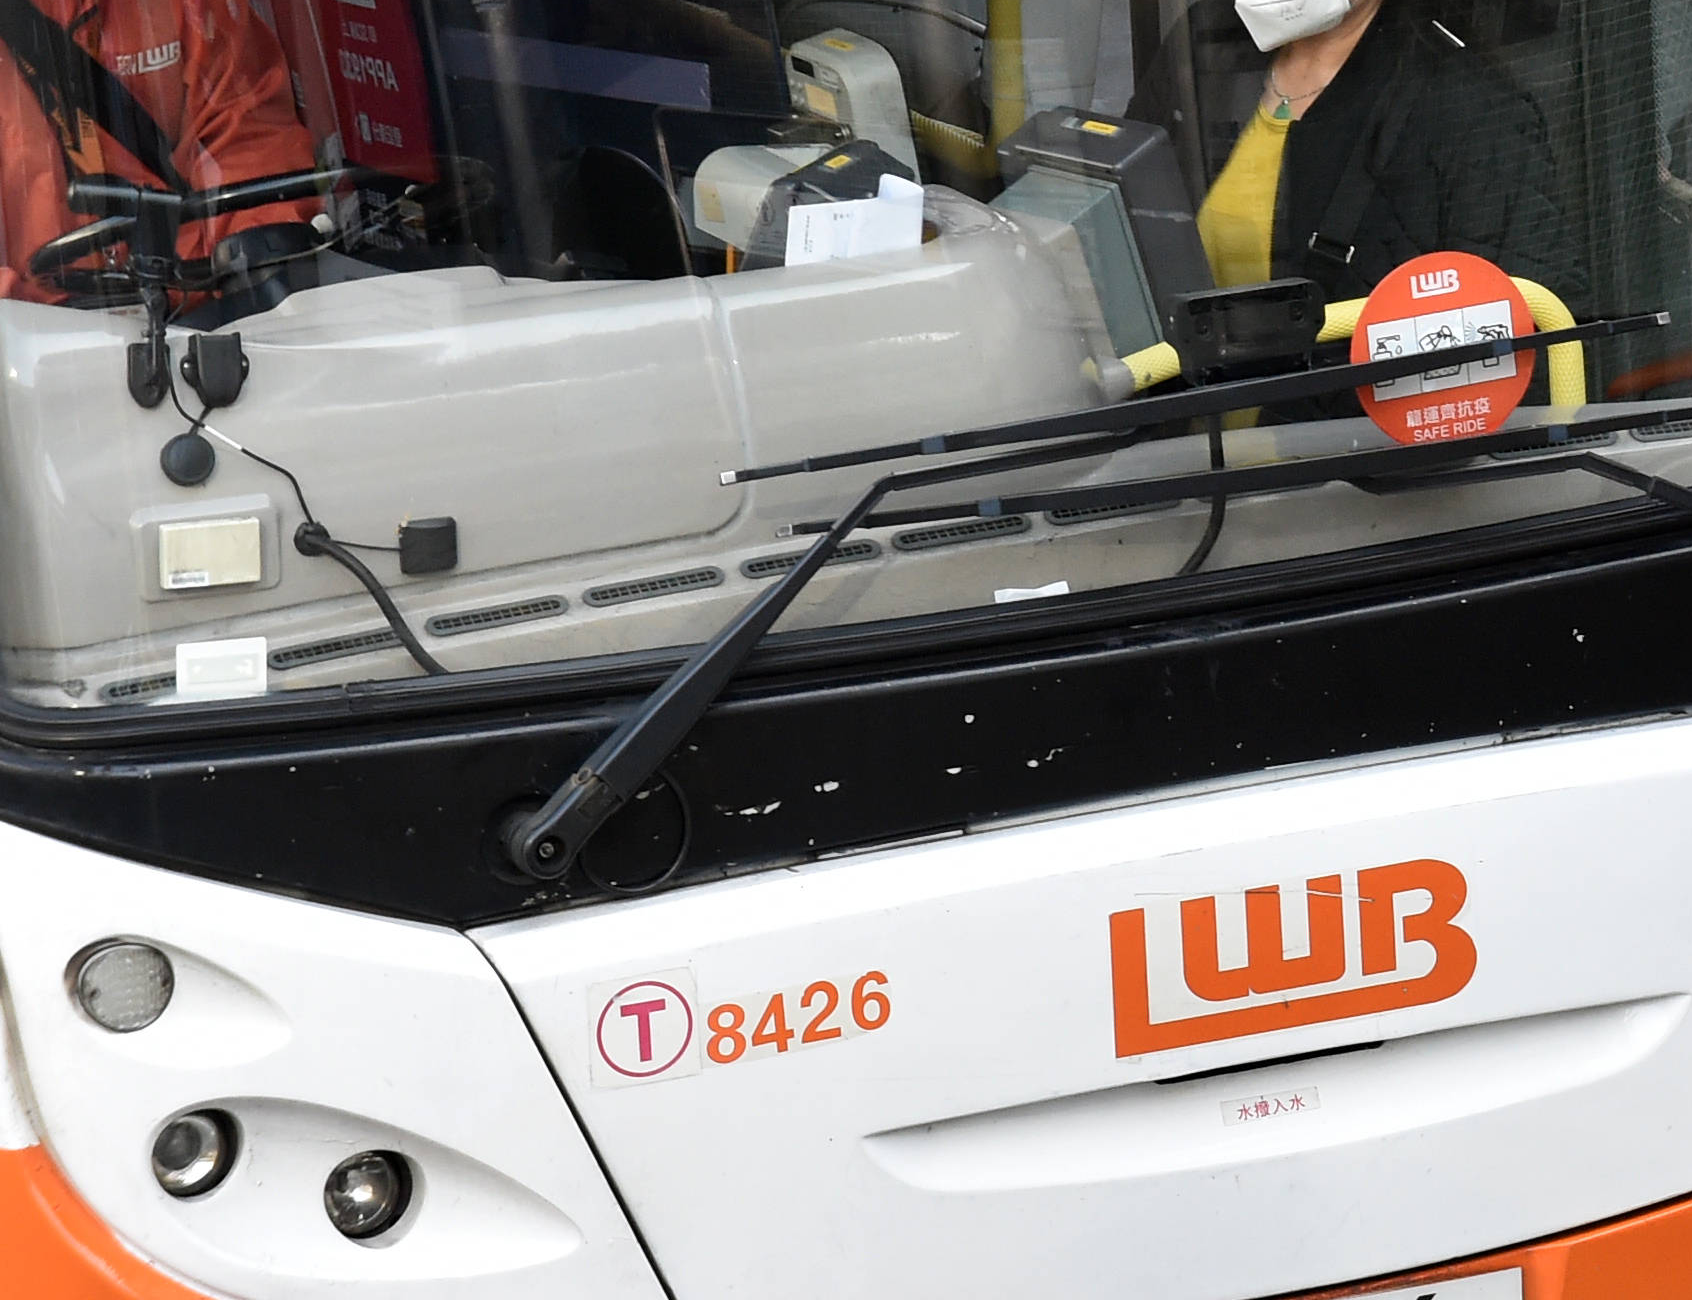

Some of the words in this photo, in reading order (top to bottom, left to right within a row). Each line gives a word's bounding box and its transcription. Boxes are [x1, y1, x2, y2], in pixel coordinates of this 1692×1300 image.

[1410, 269, 1461, 300] LWB
[1406, 397, 1492, 428] 龍運齊抗疫
[1413, 425, 1450, 442] SAFE
[1453, 417, 1488, 436] RIDE
[1109, 858, 1478, 1058] LWB
[620, 998, 666, 1062] T
[706, 970, 891, 1064] 8426
[1237, 1093, 1306, 1121] 水撥入水
